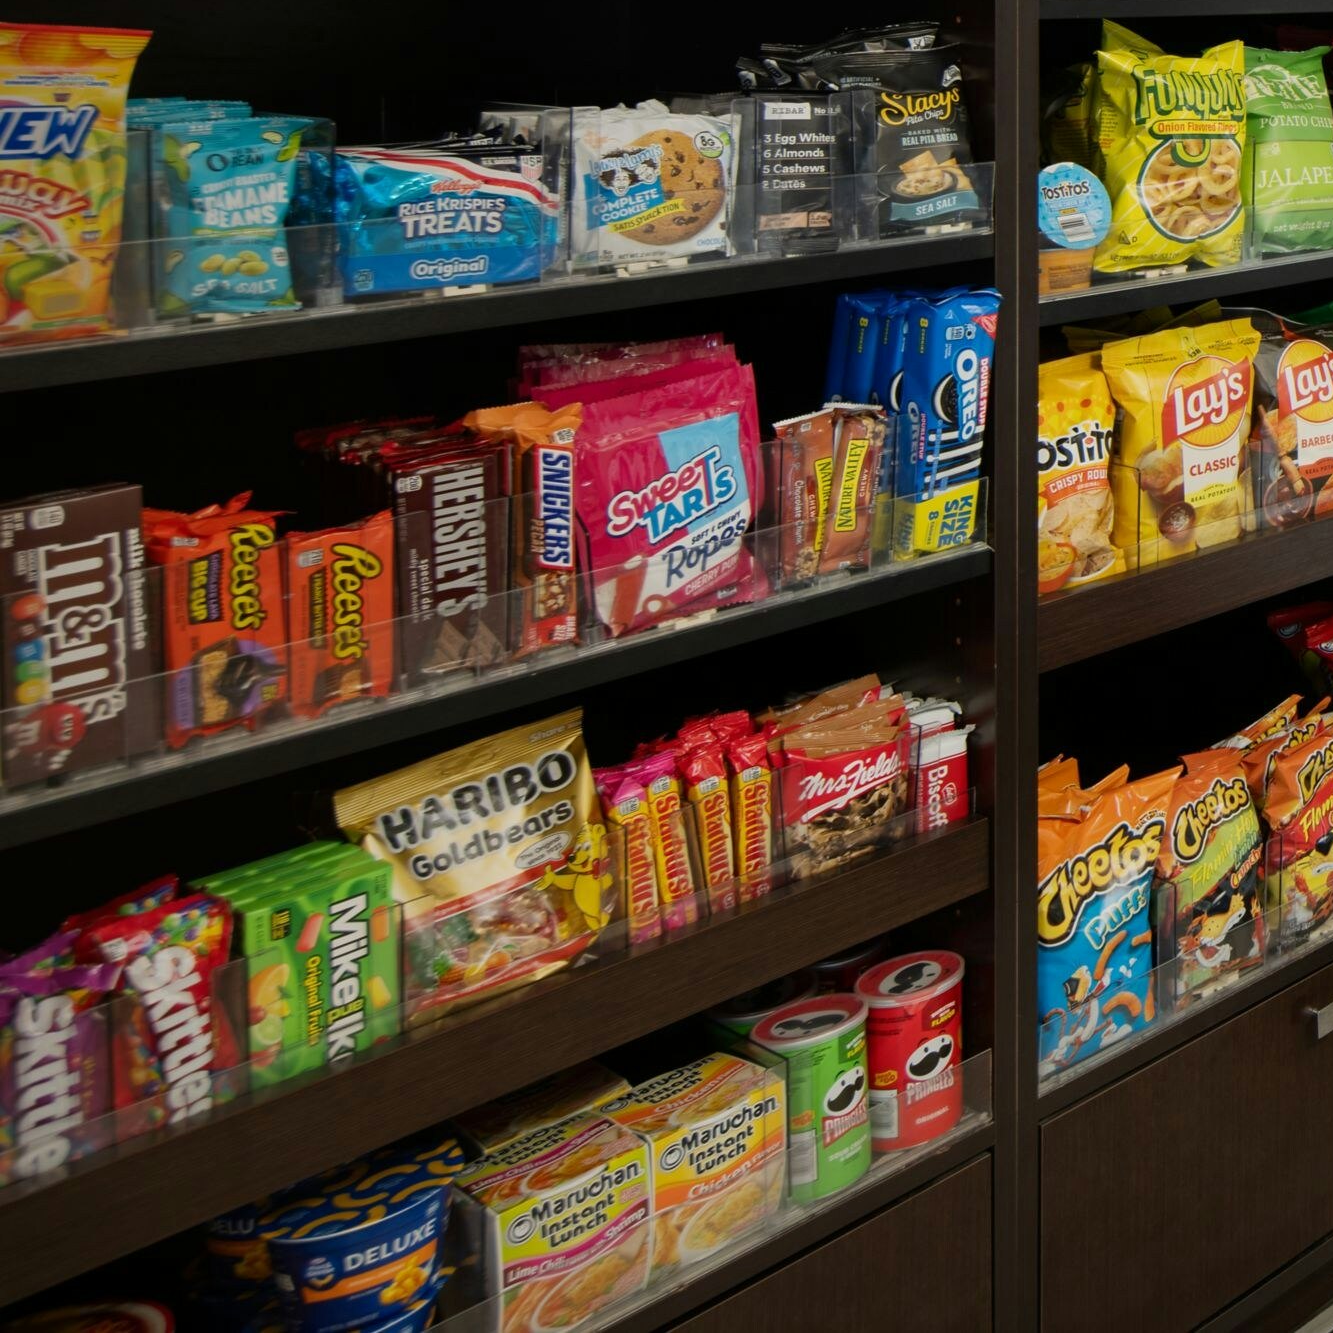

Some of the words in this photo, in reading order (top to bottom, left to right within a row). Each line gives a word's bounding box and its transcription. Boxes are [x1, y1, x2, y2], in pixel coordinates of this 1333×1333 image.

[880, 87, 960, 126] Stacy's
[1158, 121, 1185, 132] Onion
[1260, 115, 1307, 128] POTATO
[775, 134, 797, 146] Egg
[799, 132, 835, 144] Whites
[775, 147, 824, 158] Almonds
[902, 136, 918, 146] REAL
[919, 135, 935, 145] PITA
[773, 162, 825, 174] Cashews
[400, 200, 435, 216] RICE
[437, 197, 506, 212] KRISPIES
[401, 211, 503, 239] TREATS
[602, 203, 648, 222] COOKIE
[915, 202, 933, 215] SEA
[934, 196, 957, 211] SALT
[413, 258, 486, 278] Original
[956, 348, 978, 441] OREO
[1174, 368, 1246, 437] Lay's
[846, 443, 866, 481] VALLEY
[1049, 472, 1084, 493] CRISPY
[1189, 455, 1237, 477] CLASSIC
[542, 450, 571, 565] SNICKERS
[839, 483, 854, 528] NATURE
[938, 500, 958, 546] SIZE
[953, 495, 973, 544] KING
[433, 463, 488, 617] HERSHEY'S
[230, 524, 275, 630] Reese's
[332, 543, 382, 660] Reese's
[378, 750, 576, 852] HARIBO
[928, 765, 949, 830] Biscoff
[411, 800, 573, 879] Goldbears
[1174, 779, 1249, 861] Cheetos
[1039, 821, 1165, 942] Cheetos
[329, 892, 369, 1006] Mike
[906, 1066, 954, 1105] PRINGLES
[681, 1097, 776, 1151] Maruchan
[688, 1125, 754, 1166] Instant
[695, 1143, 747, 1175] Lunch
[531, 1161, 639, 1222] Maruchan
[541, 1193, 615, 1238] Instant
[550, 1212, 607, 1247] Lunch
[343, 1218, 436, 1272] DELUXE
